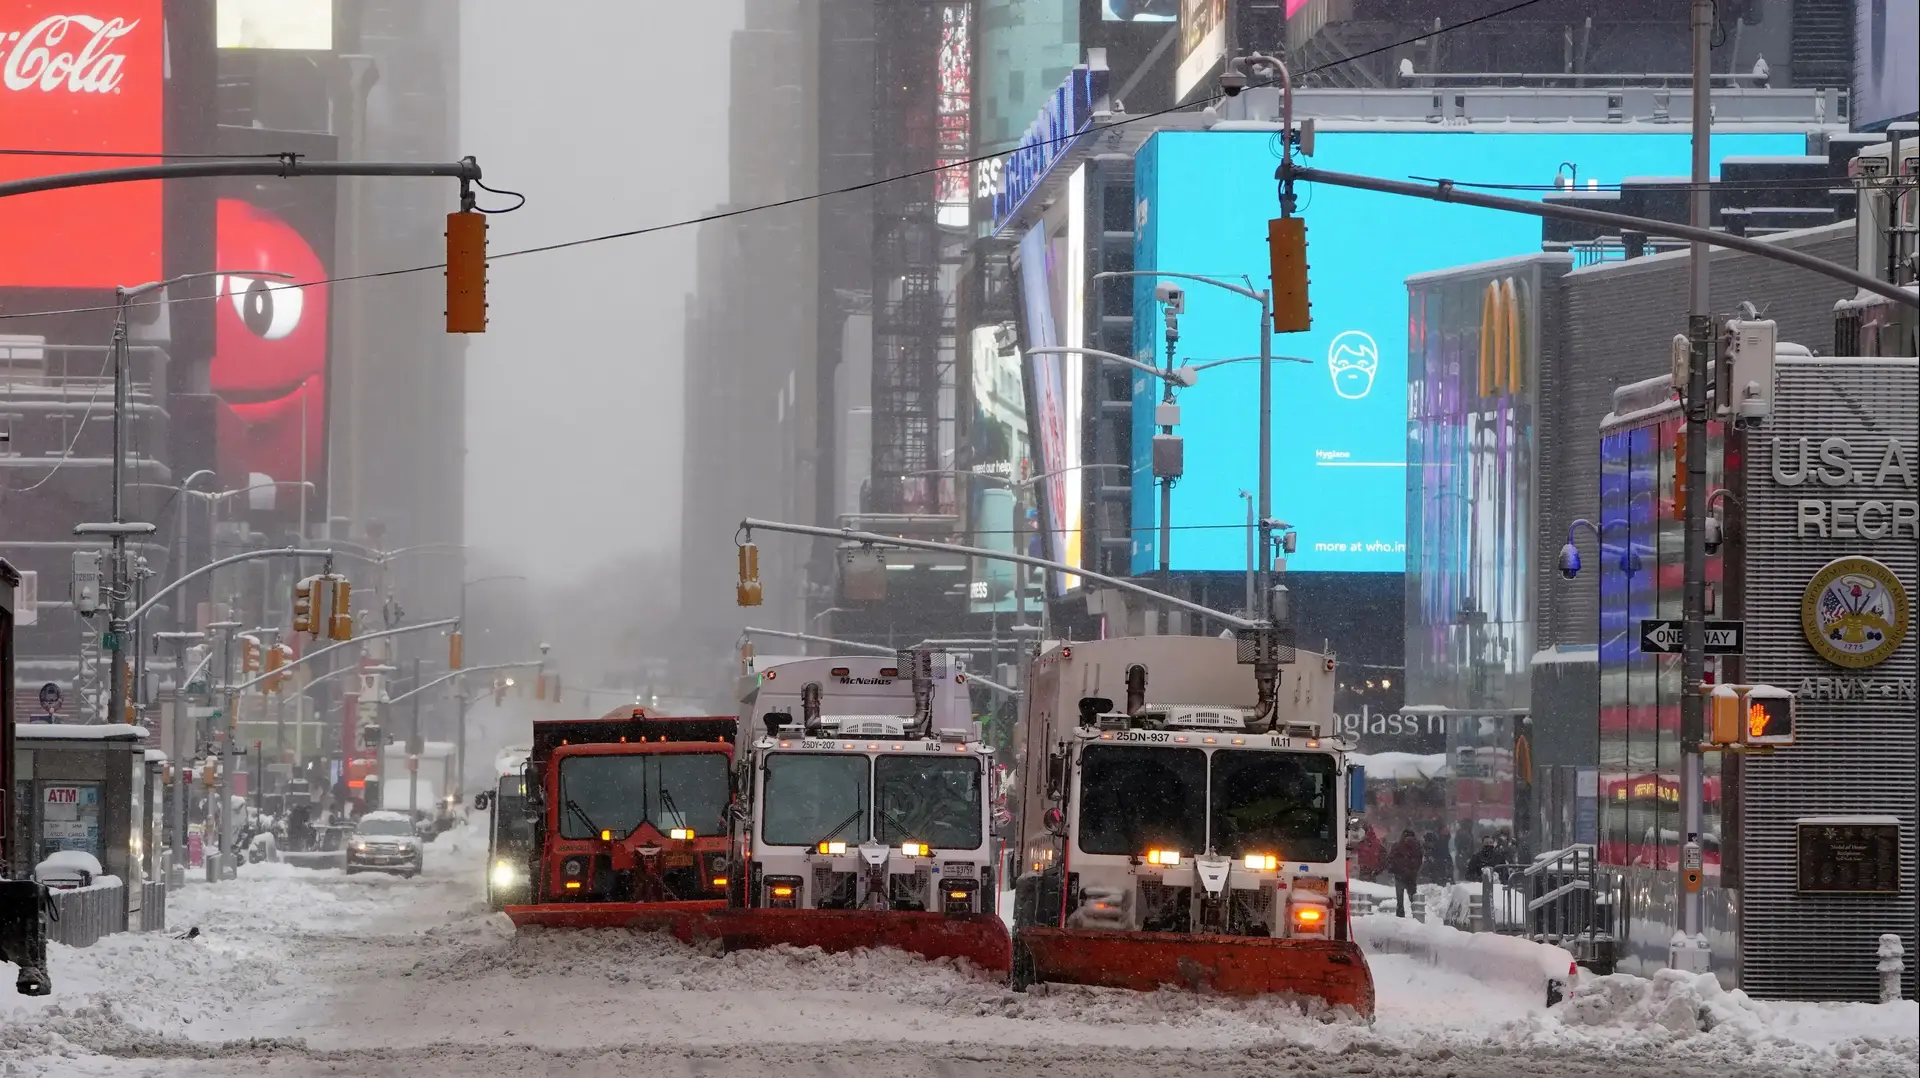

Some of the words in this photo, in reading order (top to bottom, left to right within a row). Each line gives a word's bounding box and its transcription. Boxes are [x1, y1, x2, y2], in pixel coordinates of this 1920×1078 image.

[1771, 437, 1863, 486] U.S.
[1798, 500, 1919, 539] RECR
[1315, 543, 1347, 552] more
[1350, 542, 1361, 552] at
[1656, 631, 1682, 643] ONE
[1796, 677, 1875, 700] ARMY
[1116, 732, 1169, 742] 25DN-937
[1271, 737, 1291, 747] M.11
[802, 741, 835, 749] 25DY-202
[925, 742, 941, 751] M.5
[48, 789, 76, 803] ATM
